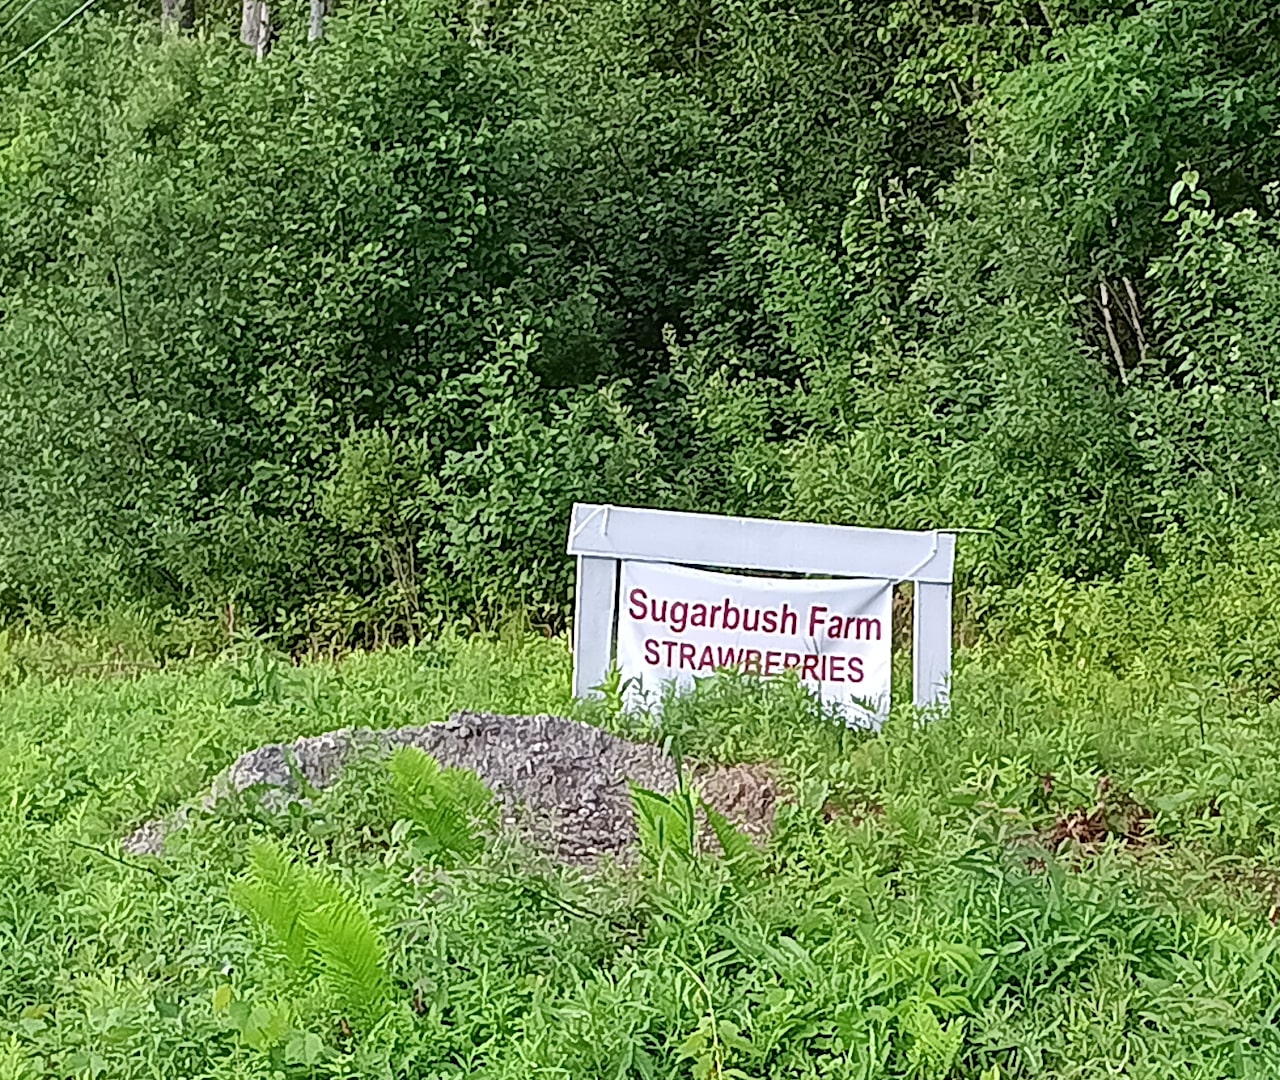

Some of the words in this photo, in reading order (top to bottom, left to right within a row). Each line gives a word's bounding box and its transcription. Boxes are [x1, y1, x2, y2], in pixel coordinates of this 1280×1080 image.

[629, 588, 797, 635] Sugarbush
[809, 606, 882, 640] Farm
[644, 639, 864, 683] STRAWBERRIES
